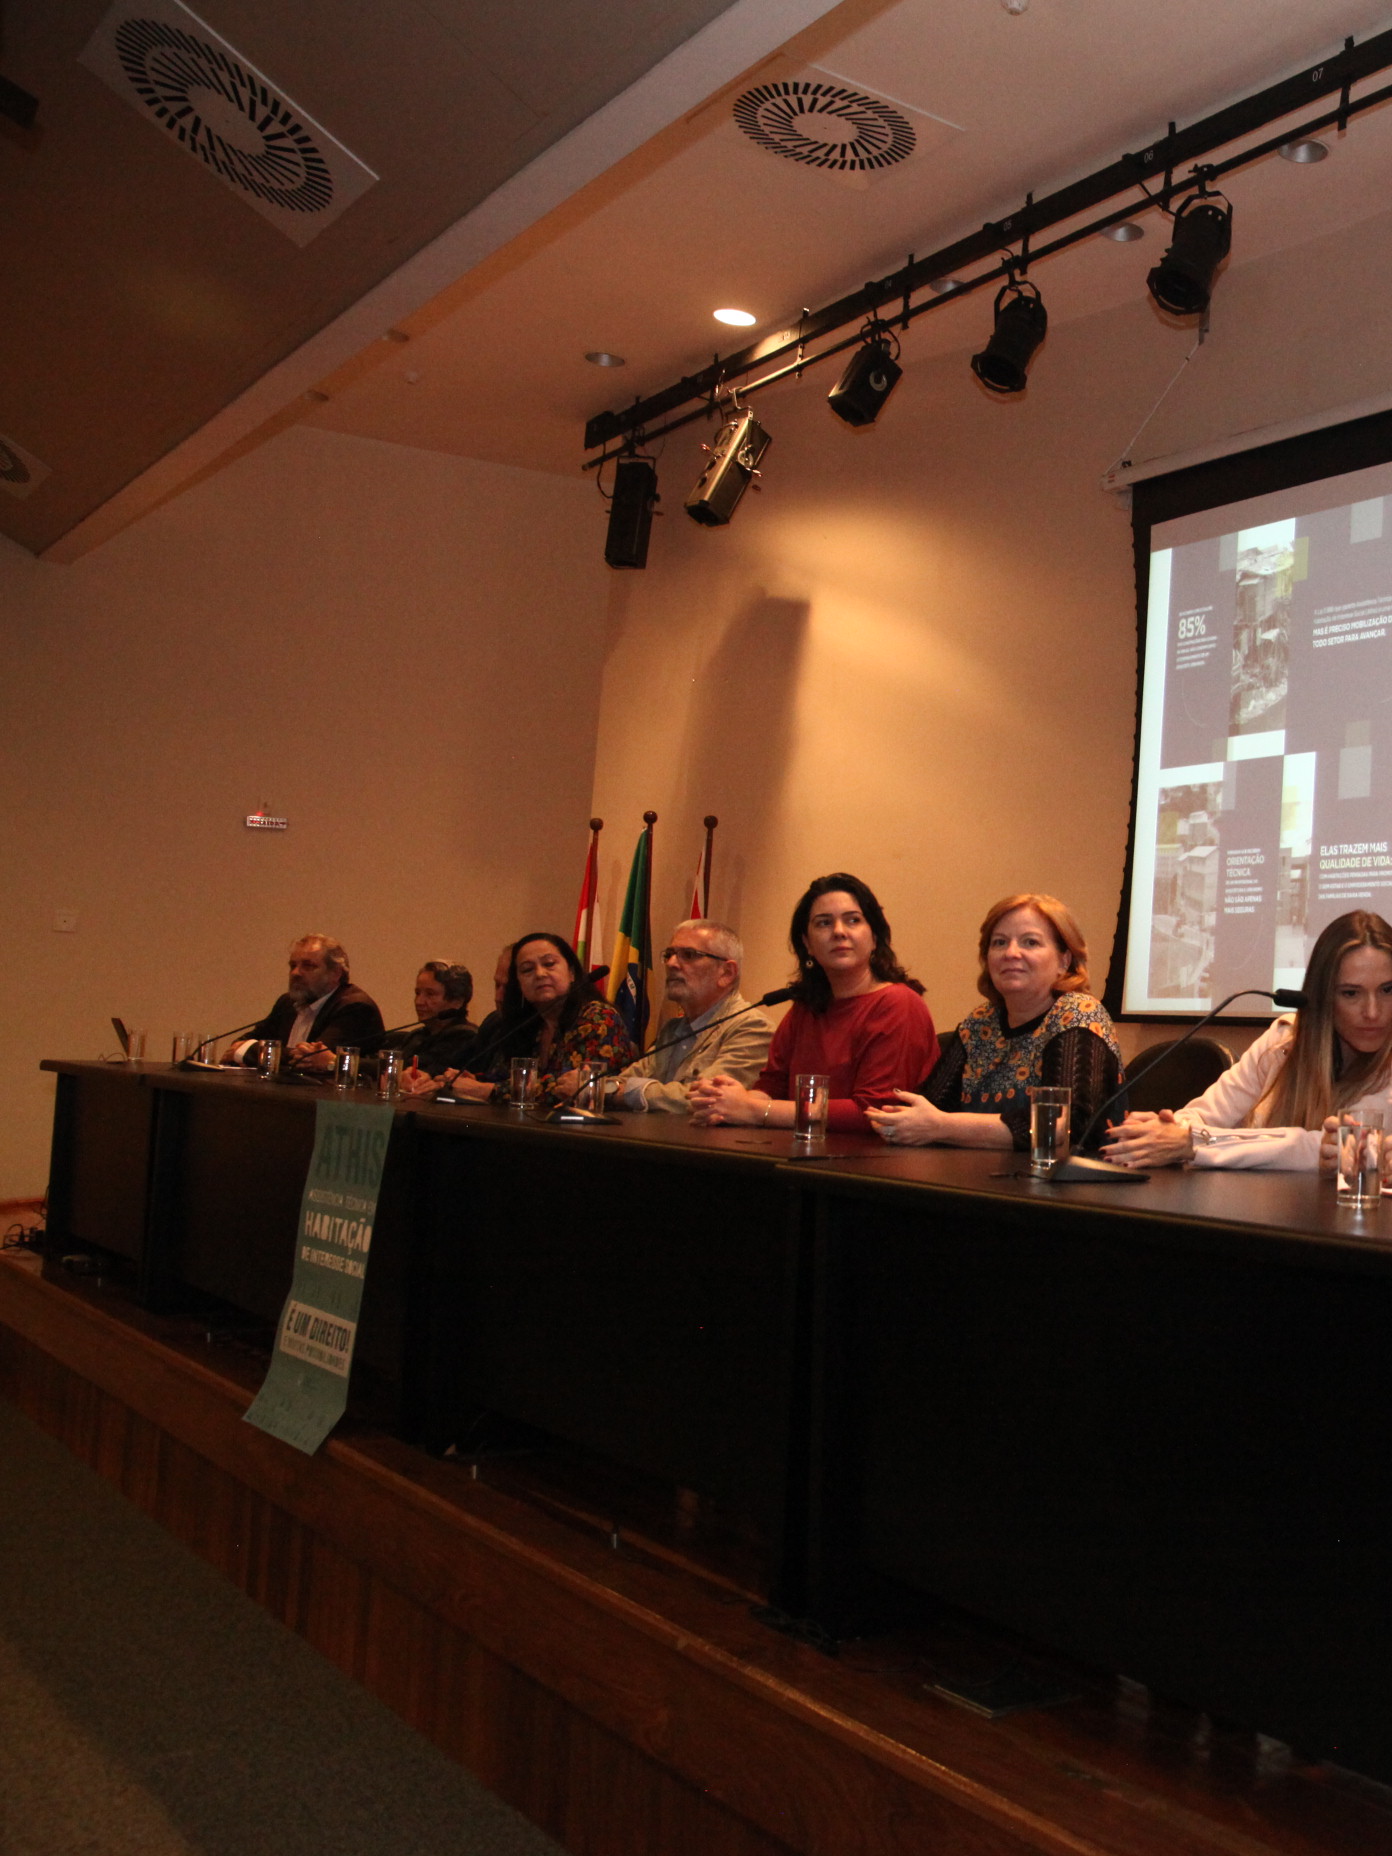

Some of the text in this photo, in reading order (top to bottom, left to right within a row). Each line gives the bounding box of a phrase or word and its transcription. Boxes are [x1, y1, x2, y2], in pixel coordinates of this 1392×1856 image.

[1312, 67, 1324, 82] 07
[1177, 614, 1206, 640] 85%
[1328, 623, 1351, 634] PRECISO
[1327, 635, 1345, 646] SETOR
[1345, 633, 1359, 643] PARA
[1320, 841, 1388, 857] ELAS TRAZEM MAIS
[1319, 855, 1392, 870] QUALIDADE DE VIDA:
[314, 1125, 386, 1188] ATHIS
[304, 1210, 373, 1256] HABITAÇÃO
[294, 1310, 312, 1338] UM
[309, 1317, 353, 1354] DIREITO!
